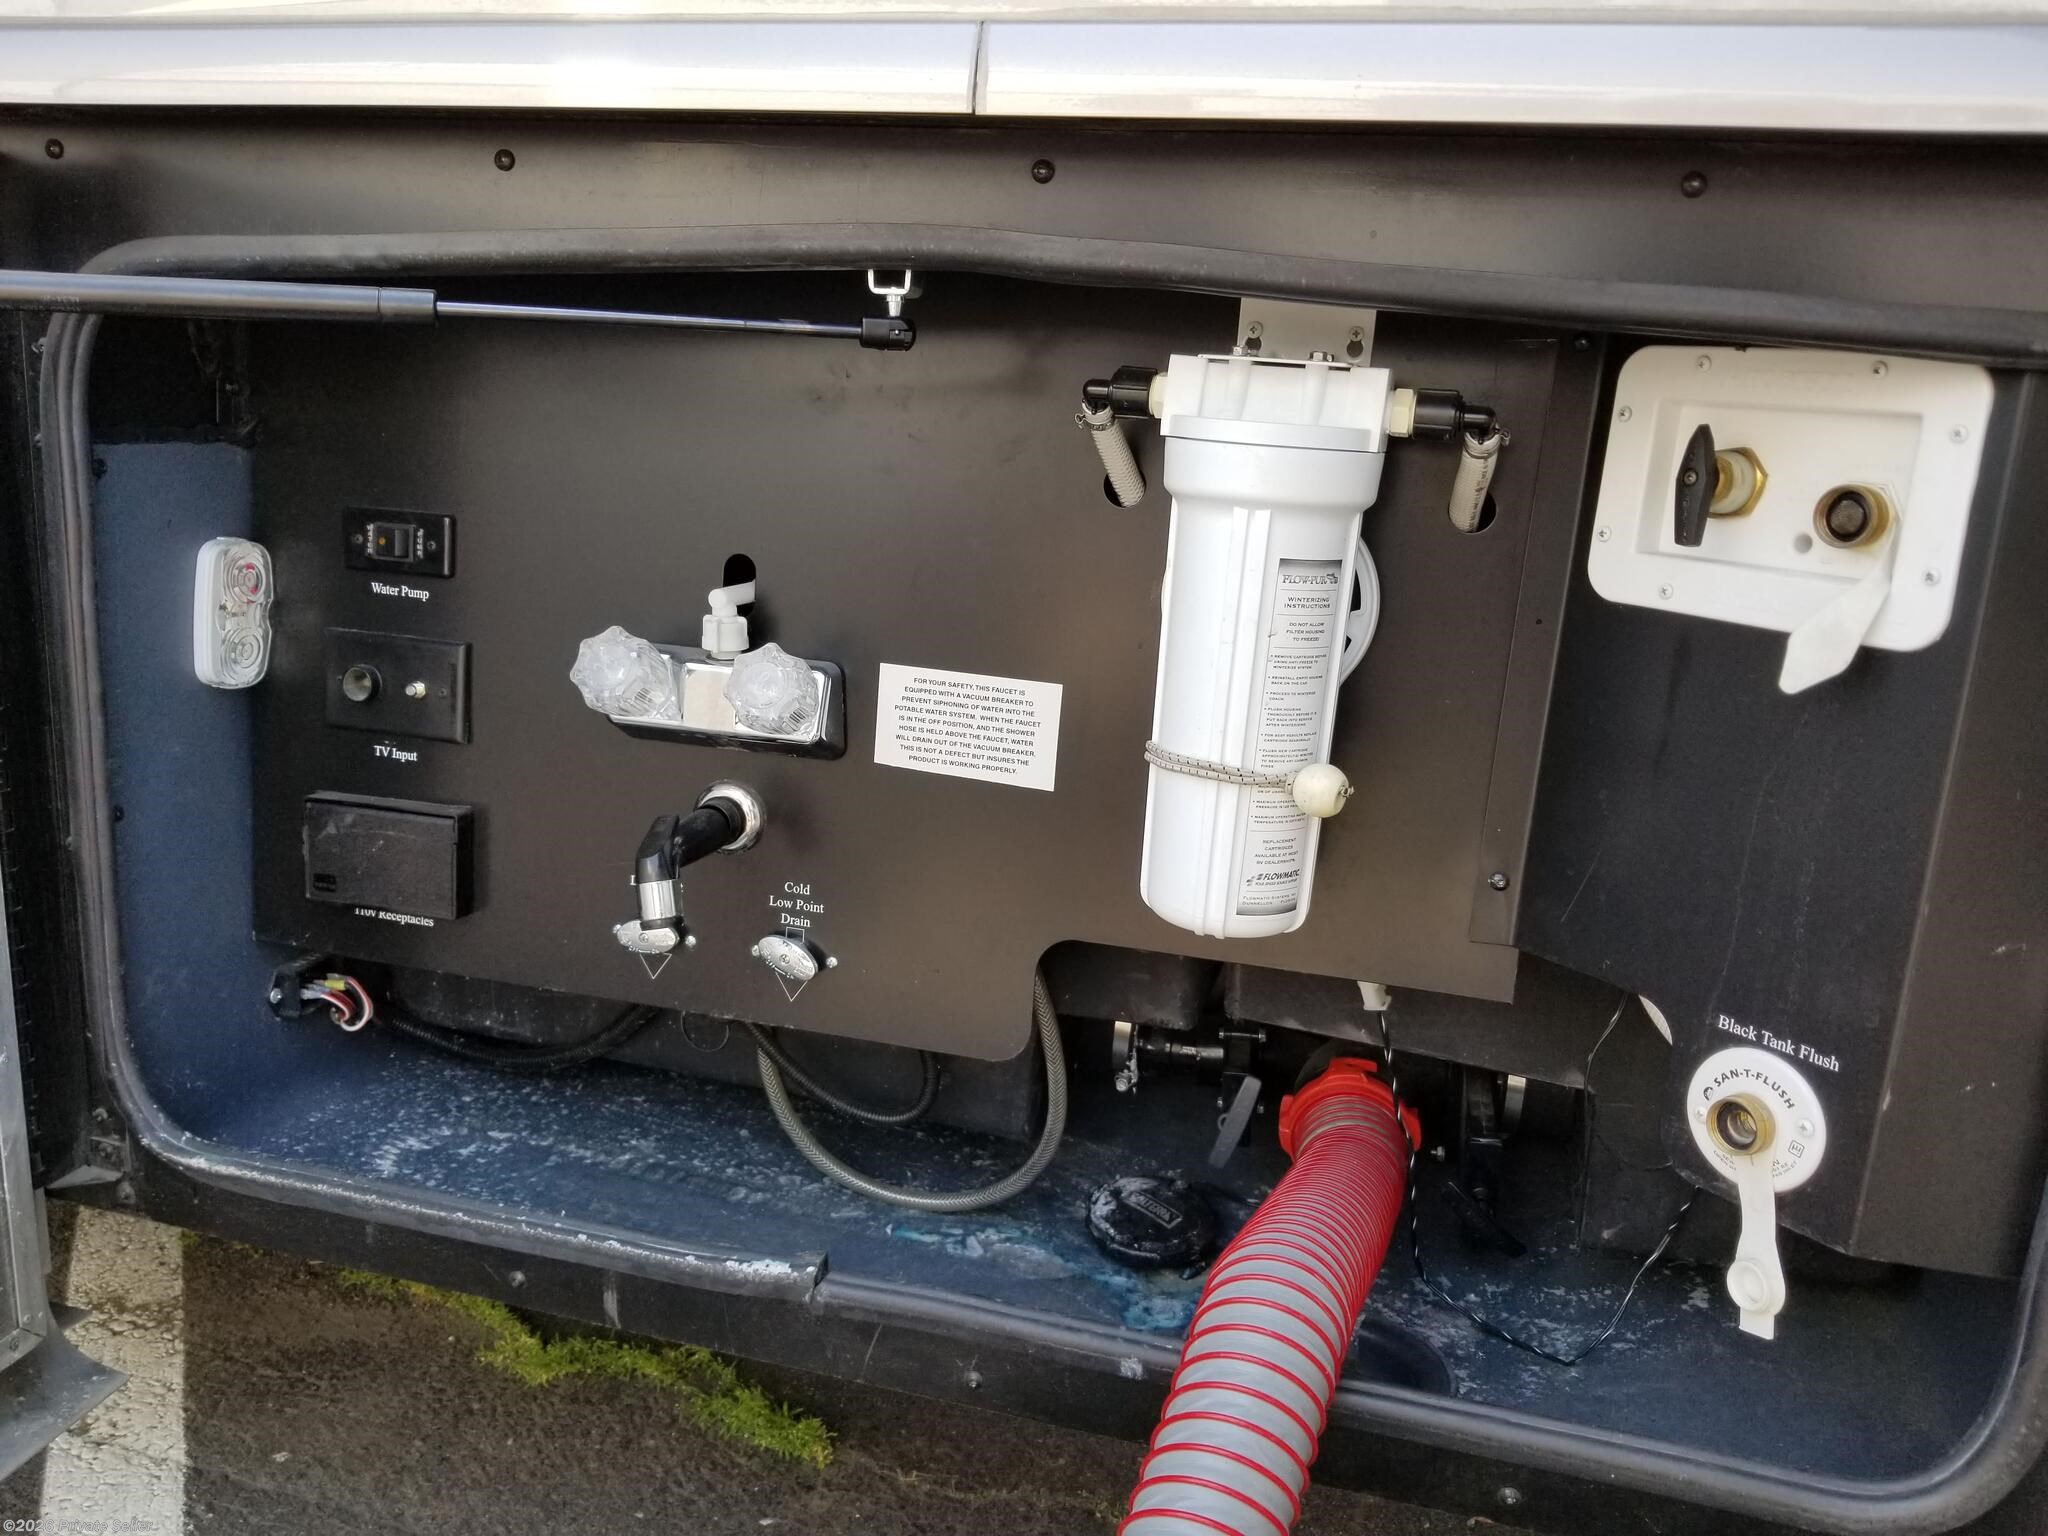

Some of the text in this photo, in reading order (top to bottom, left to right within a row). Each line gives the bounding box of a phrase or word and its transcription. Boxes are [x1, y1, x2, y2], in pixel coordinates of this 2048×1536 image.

[371, 582, 430, 601] Water Pump
[904, 686, 937, 695] EQUIPPED
[962, 693, 990, 701] VACUUM
[991, 696, 1024, 706] BREAKER
[948, 682, 974, 691] SAFETY,
[991, 687, 1017, 695] FAUCET
[902, 696, 931, 704] PREVENT
[933, 700, 969, 709] SIPHONING
[981, 705, 1004, 713] WATER
[894, 704, 924, 714] POTABLE
[949, 711, 977, 719] SYSTEM.
[980, 715, 1000, 723] WHEN
[1015, 719, 1041, 727] FAUCET
[942, 720, 975, 730] POSITION,
[1006, 728, 1035, 737] SHOWER
[912, 736, 932, 744] DRAIN
[973, 744, 1001, 752] VACUUM
[1002, 747, 1036, 756] BREAKER.
[945, 730, 967, 738] ABOVE
[983, 735, 1009, 744] FAUCET,
[1011, 739, 1033, 747] WATER
[374, 745, 418, 762] TV Input
[945, 750, 970, 758] DEFECT
[987, 755, 1016, 764] INSURES
[909, 755, 940, 764] PRODUCT
[949, 760, 980, 769] WORKING
[981, 764, 1018, 774] PROPERLY.
[1263, 869, 1300, 880] FLOWMATIC
[784, 882, 810, 895] Cold
[769, 895, 824, 913] Low Point
[378, 911, 434, 926] Receptacles
[780, 913, 810, 927] Drain
[1718, 1014, 1840, 1072] Black Tank Flush
[1714, 1068, 1795, 1109] SAN-T-FLUSH
